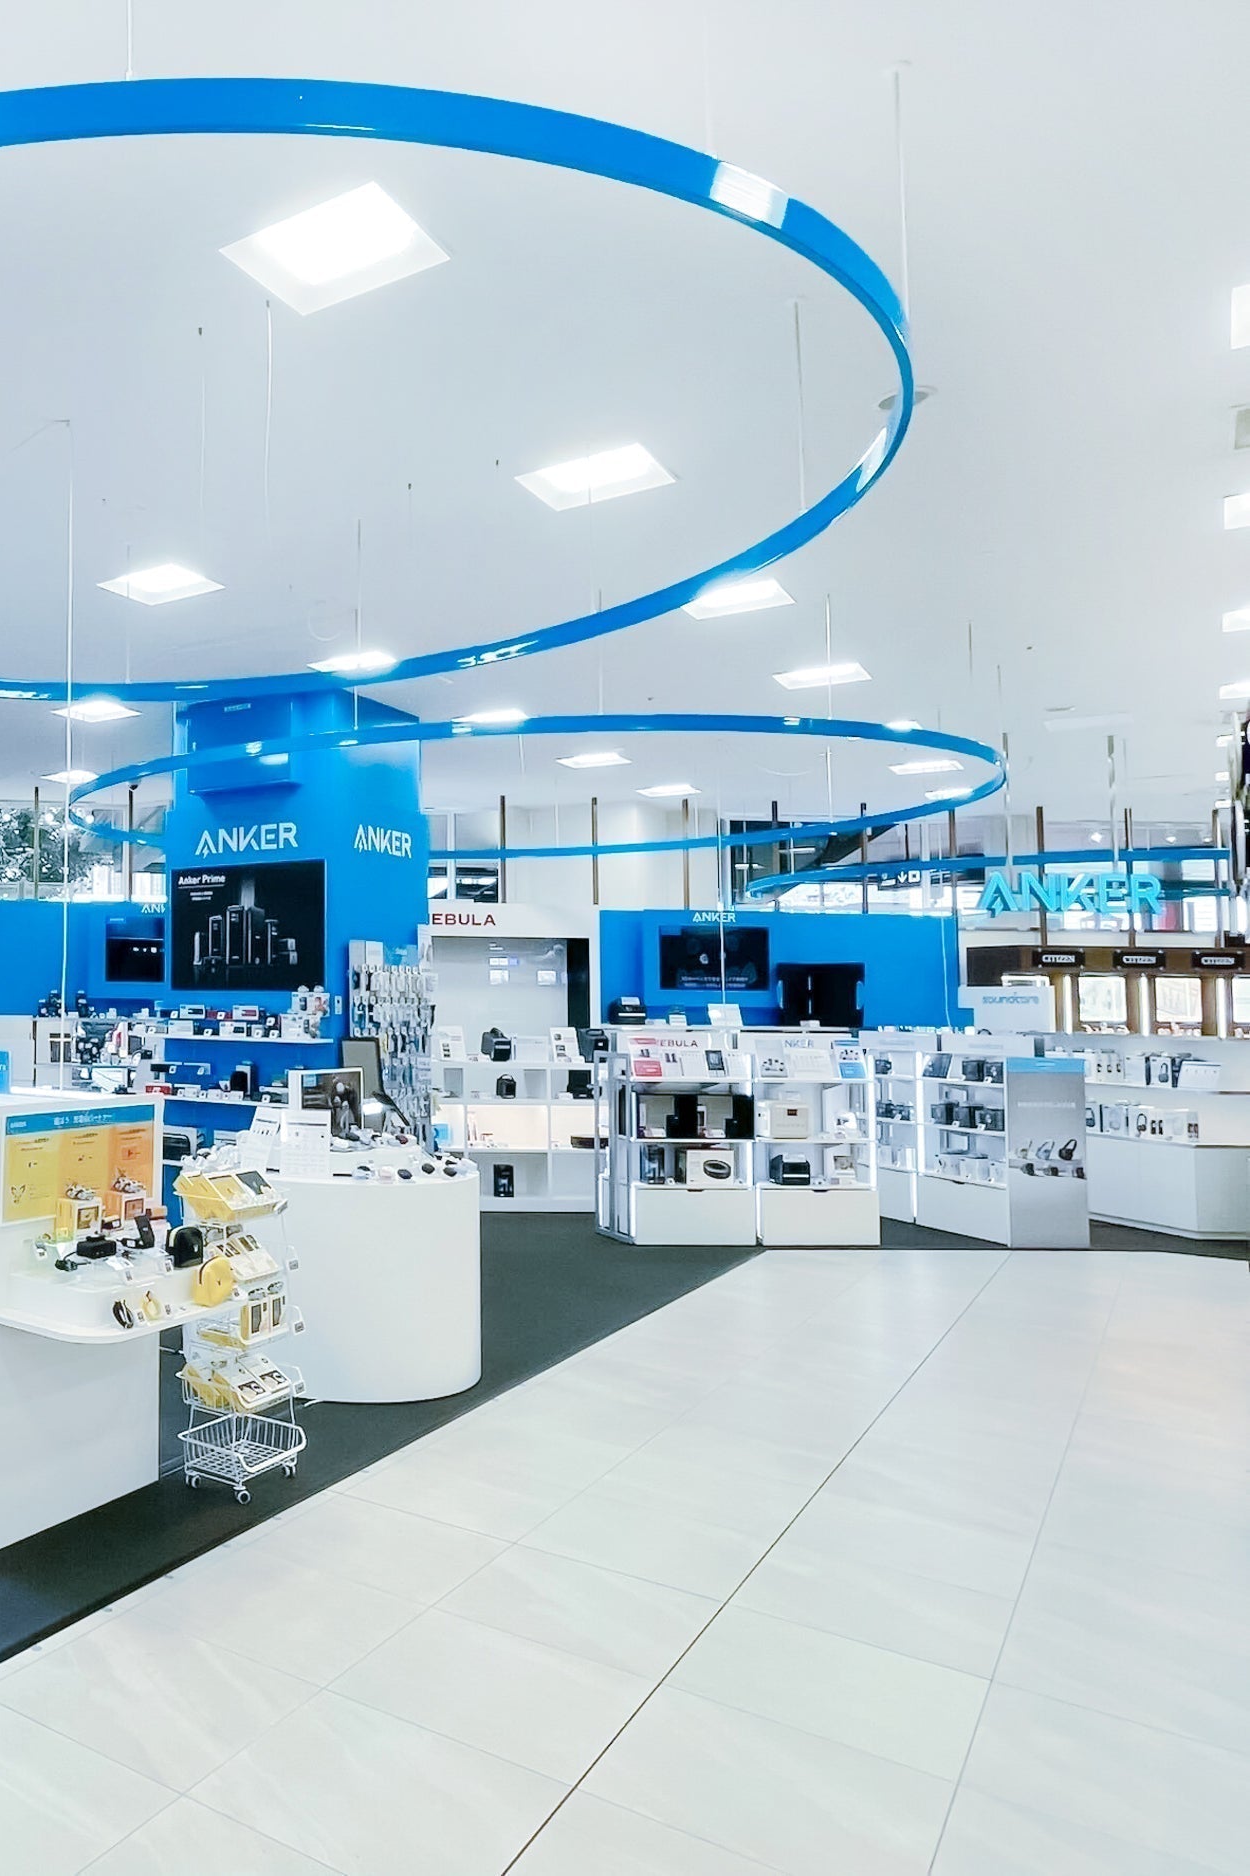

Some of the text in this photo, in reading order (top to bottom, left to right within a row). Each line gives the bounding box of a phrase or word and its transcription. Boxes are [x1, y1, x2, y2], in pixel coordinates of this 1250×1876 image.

[195, 822, 298, 859] ANKER
[353, 824, 413, 858] ANKER
[178, 873, 226, 886] Anker Prime
[978, 872, 1161, 916] ANKER
[432, 913, 496, 926] EBULA
[693, 911, 736, 923] ANKER
[659, 1039, 698, 1047] EBULA
[784, 1038, 814, 1047] NKER
